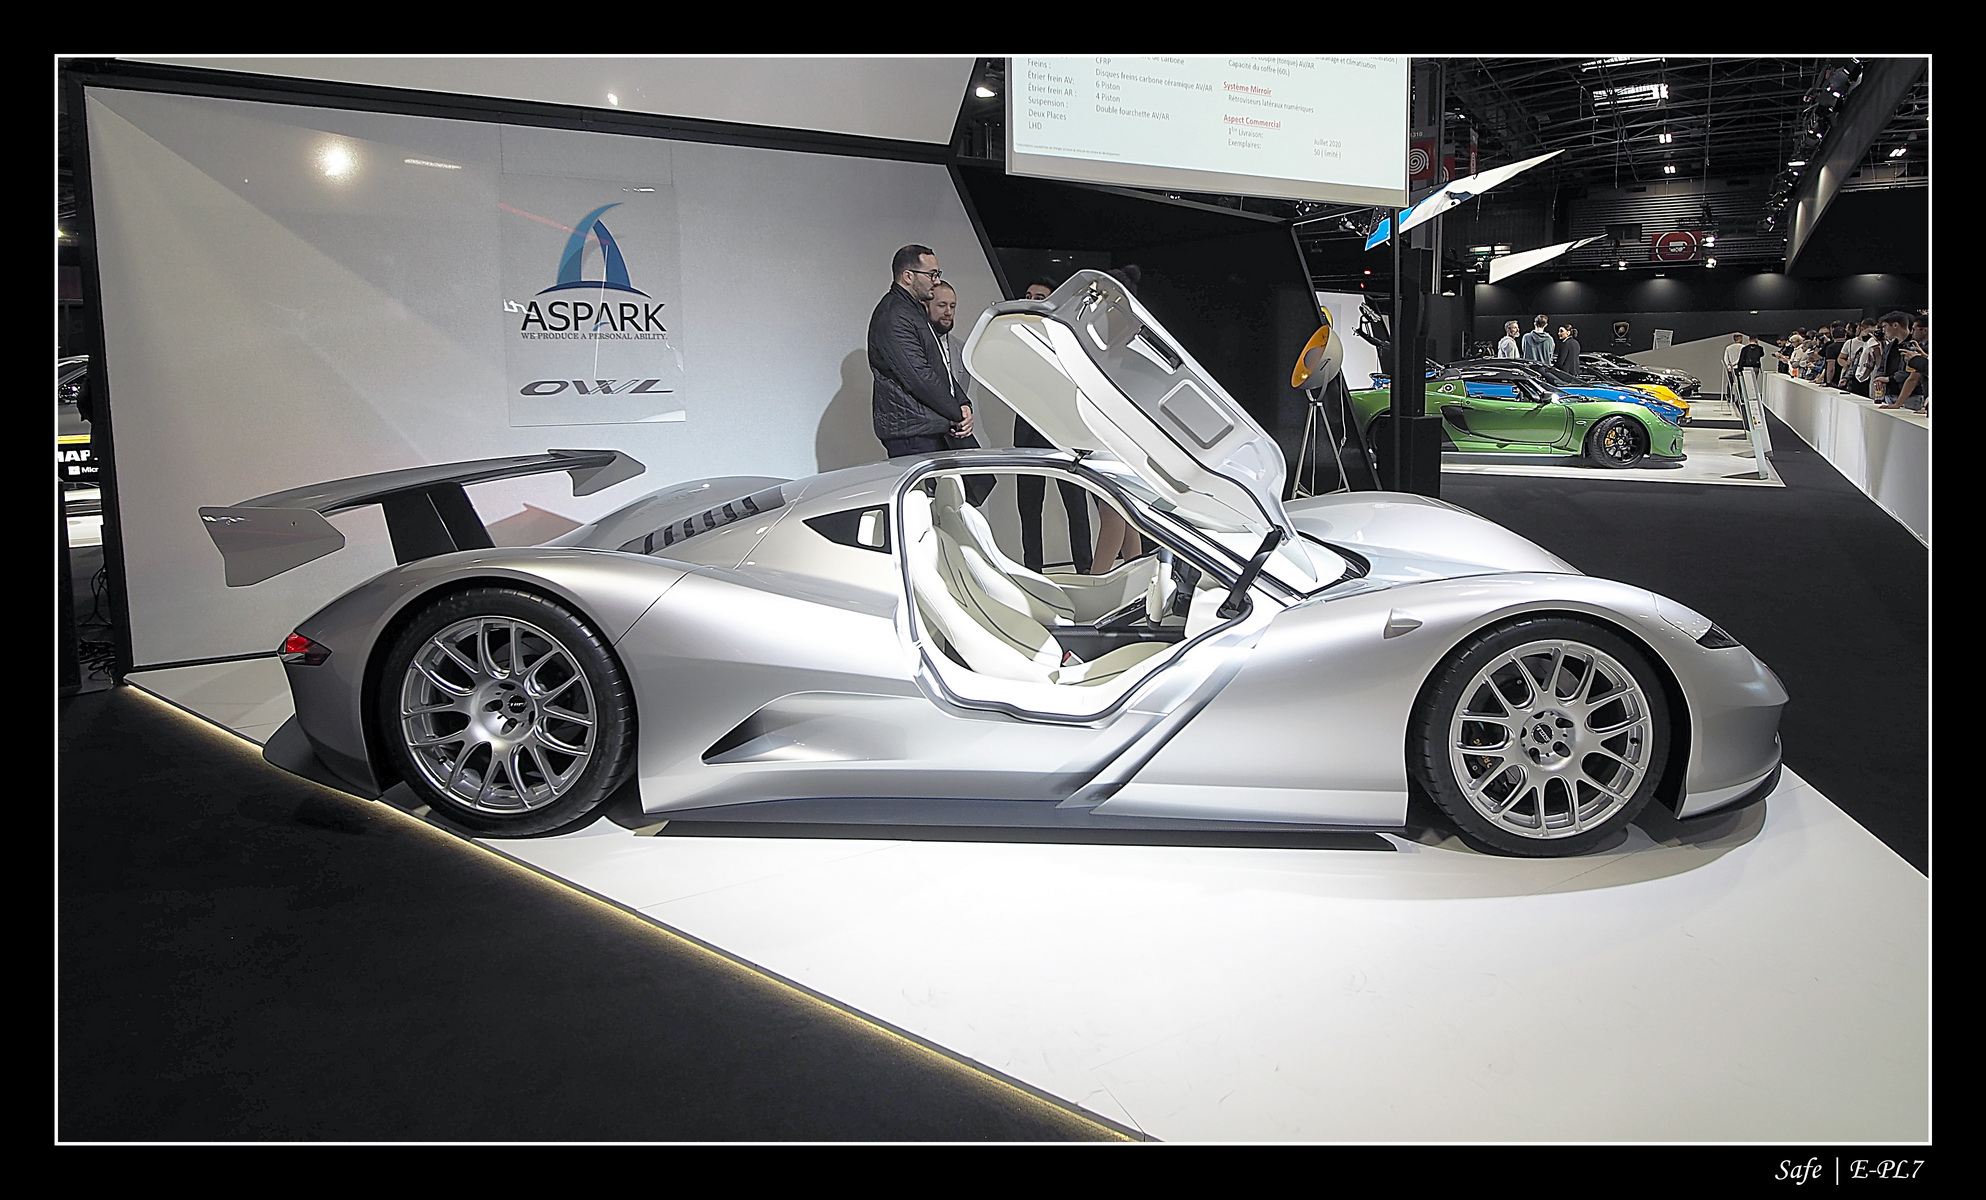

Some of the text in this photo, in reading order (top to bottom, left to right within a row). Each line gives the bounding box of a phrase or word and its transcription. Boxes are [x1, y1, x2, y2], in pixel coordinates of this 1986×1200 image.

[1027, 58, 1048, 69] Freins
[1095, 57, 1112, 65] CFRP
[1228, 59, 1252, 70] Capacité
[1252, 63, 1260, 71] du
[1260, 65, 1276, 74] coffre
[1047, 73, 1063, 83] frein
[1095, 68, 1213, 92] Disques freins carbone céramique AV/AR
[1047, 86, 1063, 95] frein
[1101, 81, 1121, 91] Piston
[1223, 81, 1249, 92] Système
[1028, 96, 1065, 108] Suspension
[1095, 92, 1121, 103] 4 Piston
[1028, 108, 1067, 121] Deux Places
[1095, 104, 1170, 121] Double fourchette AV/AR
[1028, 121, 1043, 130] LHD
[1223, 114, 1281, 129] Aspect Commercial
[1329, 140, 1342, 148] 2020
[521, 301, 667, 332] ASPARK
[521, 332, 536, 340] WE
[537, 332, 579, 340] PRODUCE
[580, 332, 588, 340] A
[588, 332, 633, 340] PERSONAL
[520, 379, 674, 396] OWL
